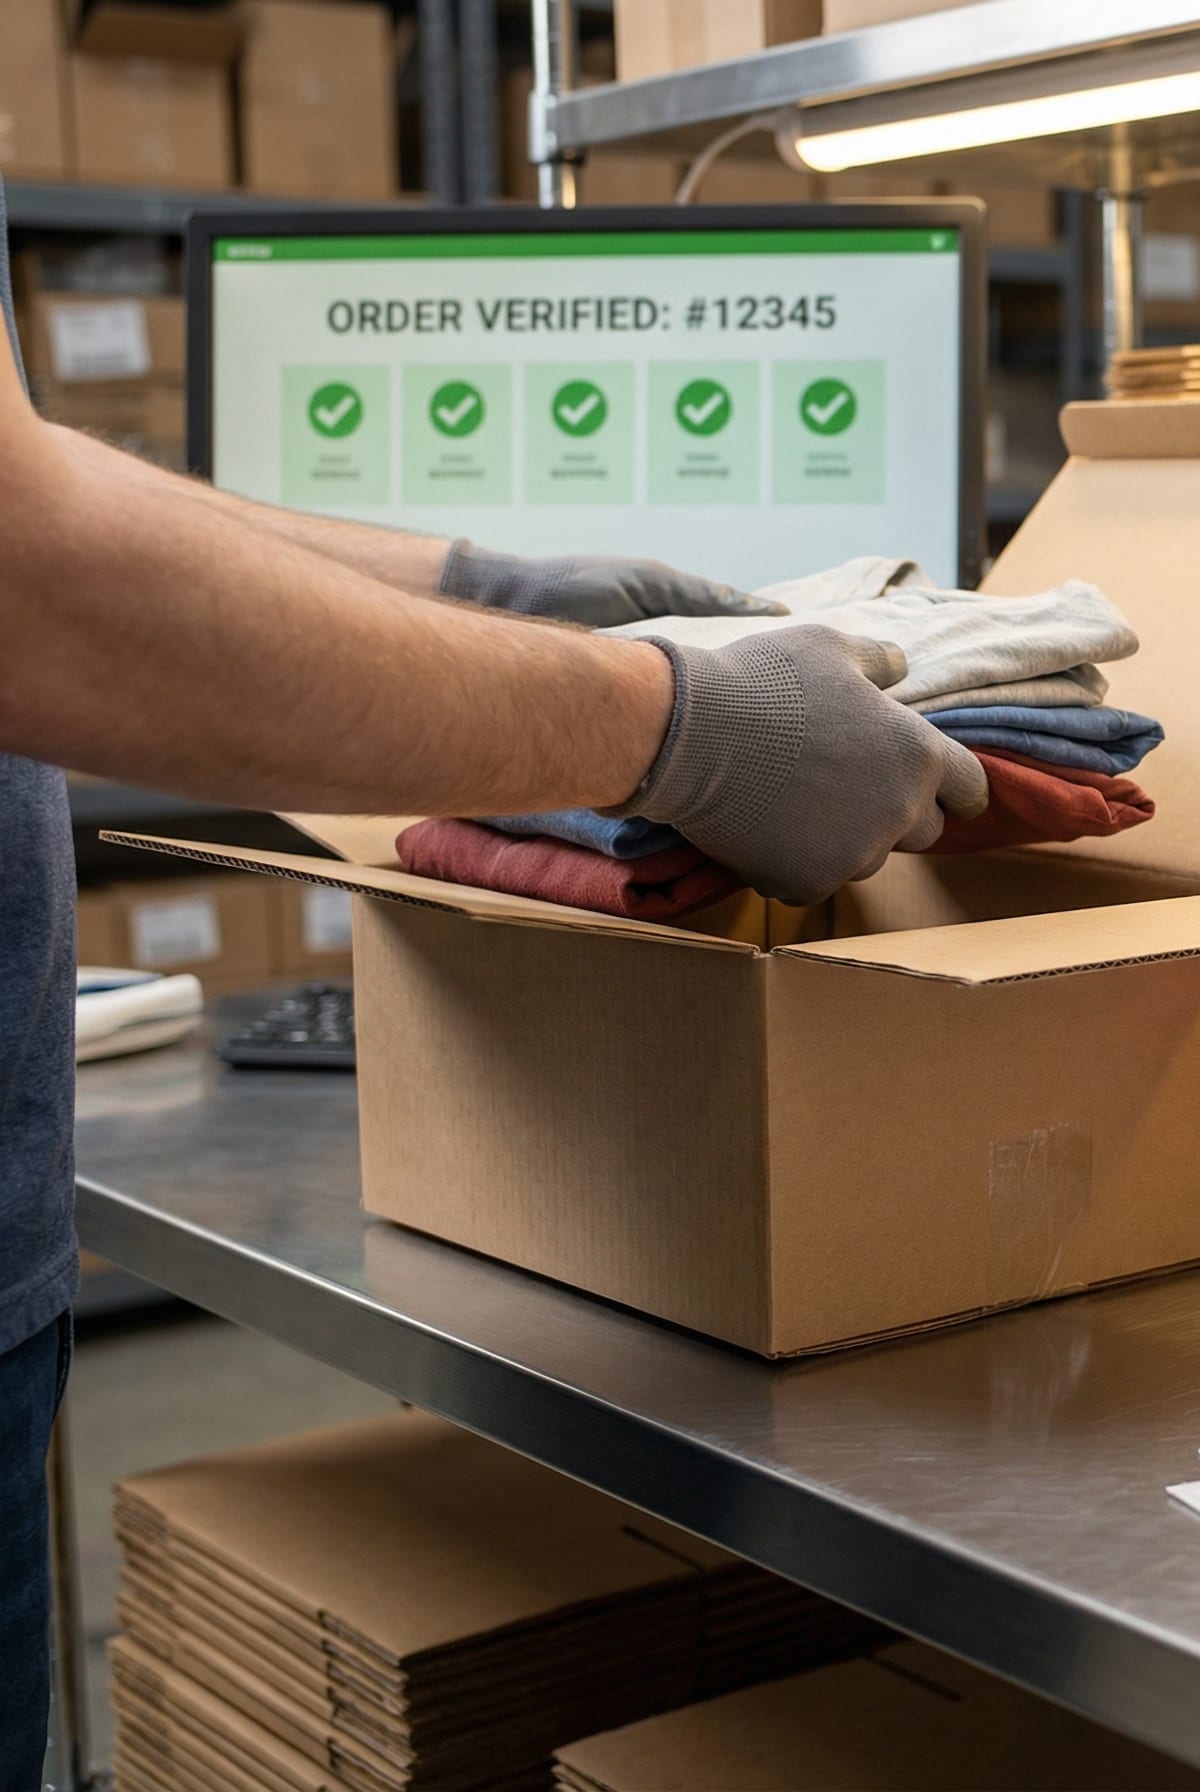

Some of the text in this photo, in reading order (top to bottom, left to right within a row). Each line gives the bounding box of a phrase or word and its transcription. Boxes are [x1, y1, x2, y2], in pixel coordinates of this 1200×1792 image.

[327, 294, 837, 334] ORDER VERIFIED: #12345
